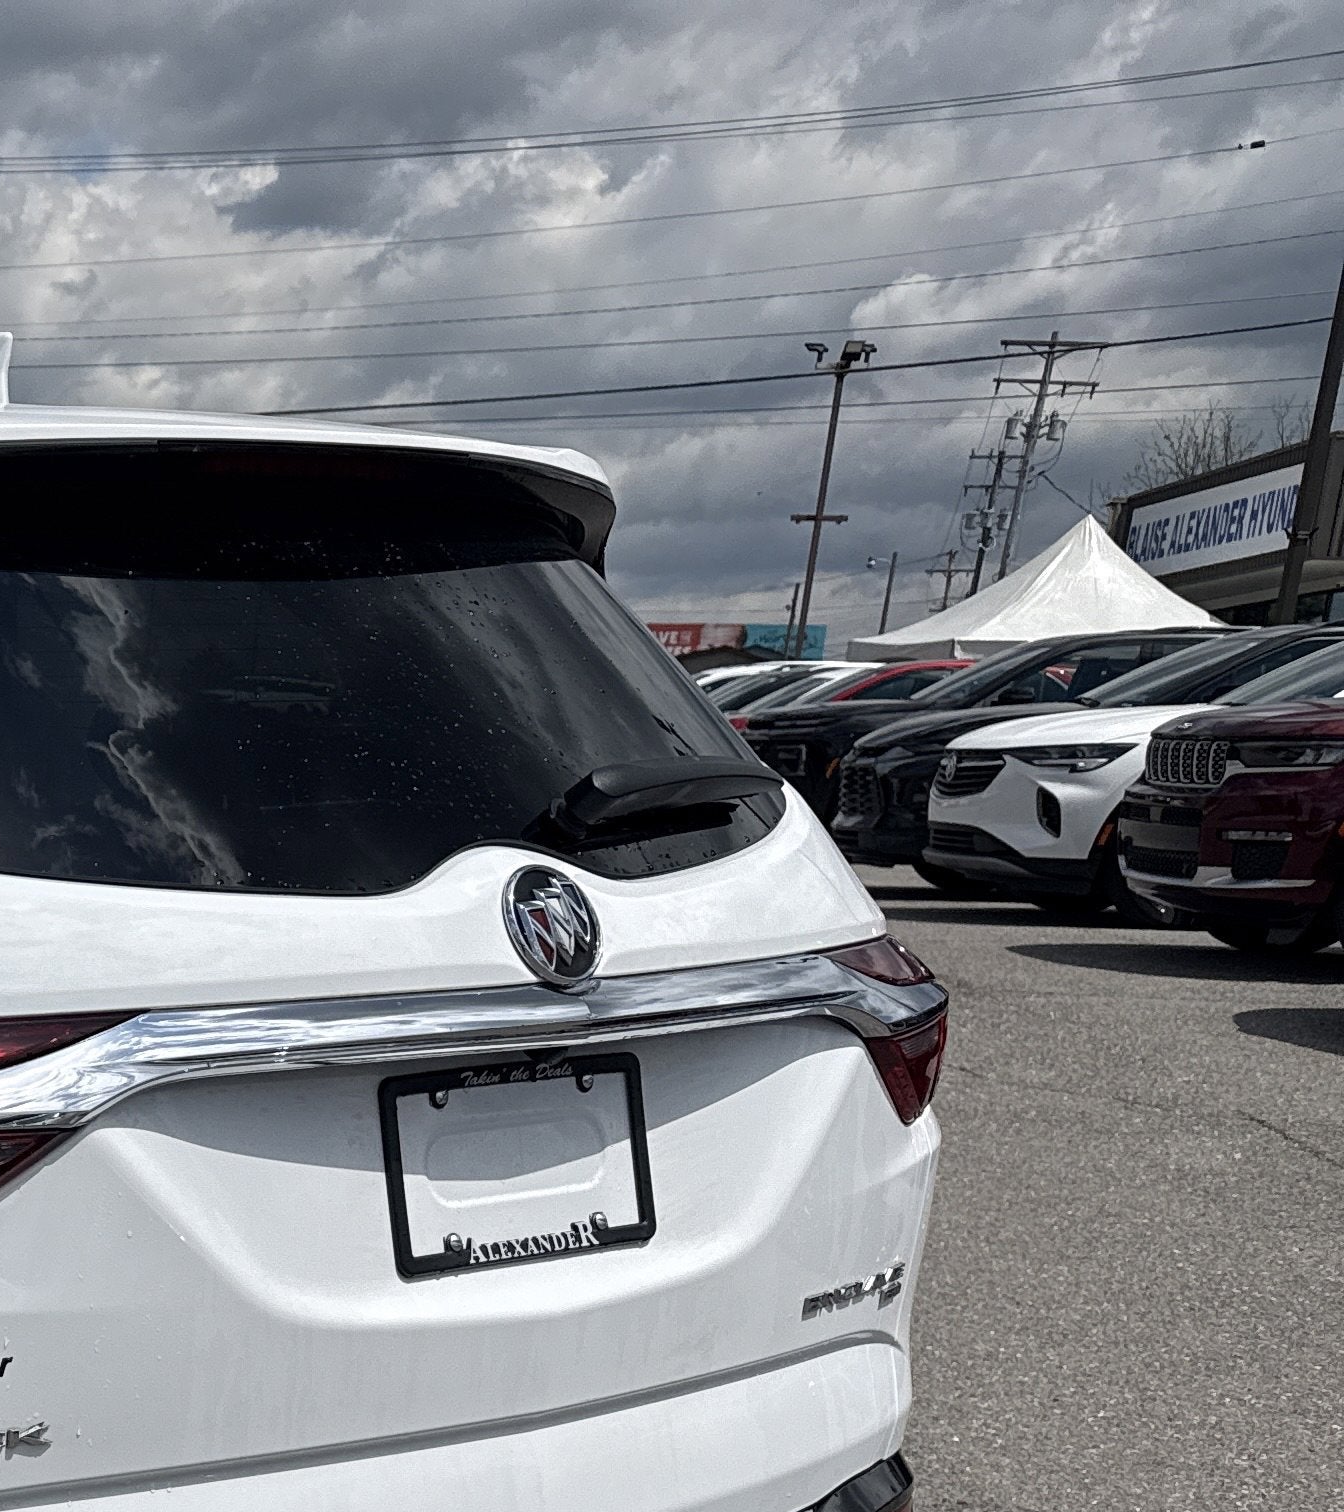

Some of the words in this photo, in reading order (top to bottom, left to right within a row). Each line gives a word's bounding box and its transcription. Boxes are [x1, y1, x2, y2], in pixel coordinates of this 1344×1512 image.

[1168, 498, 1248, 557] ALEXANDER
[510, 1066, 530, 1081] the
[536, 1063, 573, 1079] Deals
[468, 1221, 600, 1264] ALEXANDER
